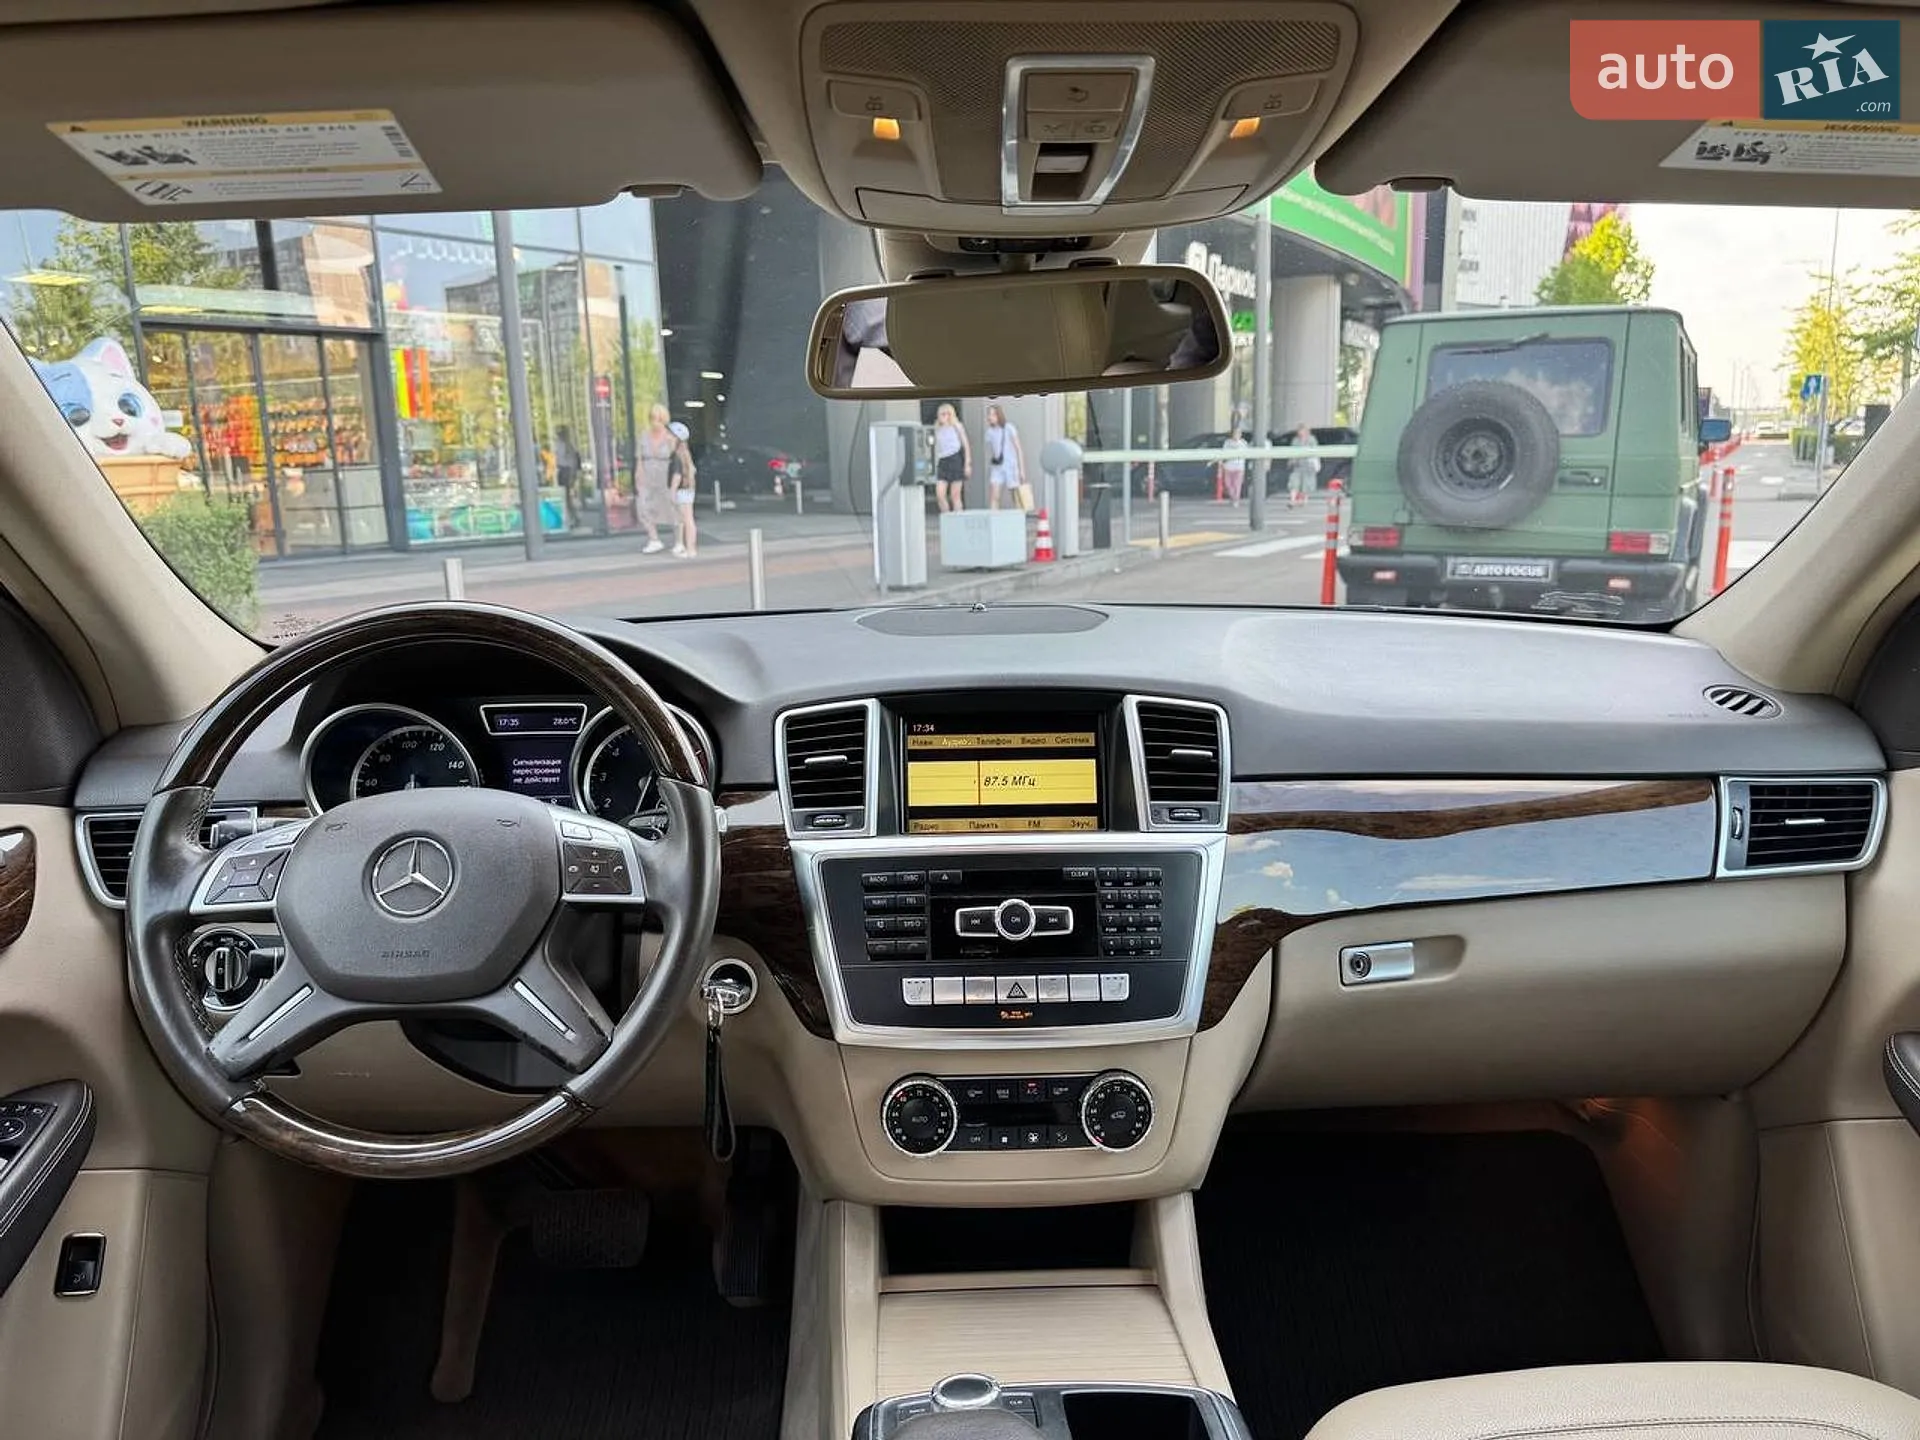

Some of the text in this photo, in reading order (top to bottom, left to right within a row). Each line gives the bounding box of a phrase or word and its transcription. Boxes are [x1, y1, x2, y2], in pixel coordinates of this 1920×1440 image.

[182, 115, 269, 128] WARNING
[1505, 565, 1543, 577] FOCUS
[913, 723, 935, 733] 17:34
[429, 743, 445, 751] 120
[448, 760, 465, 769] 140
[984, 775, 1036, 787] 87.5 МГц
[603, 797, 612, 808] 2
[1027, 819, 1041, 828] FM
